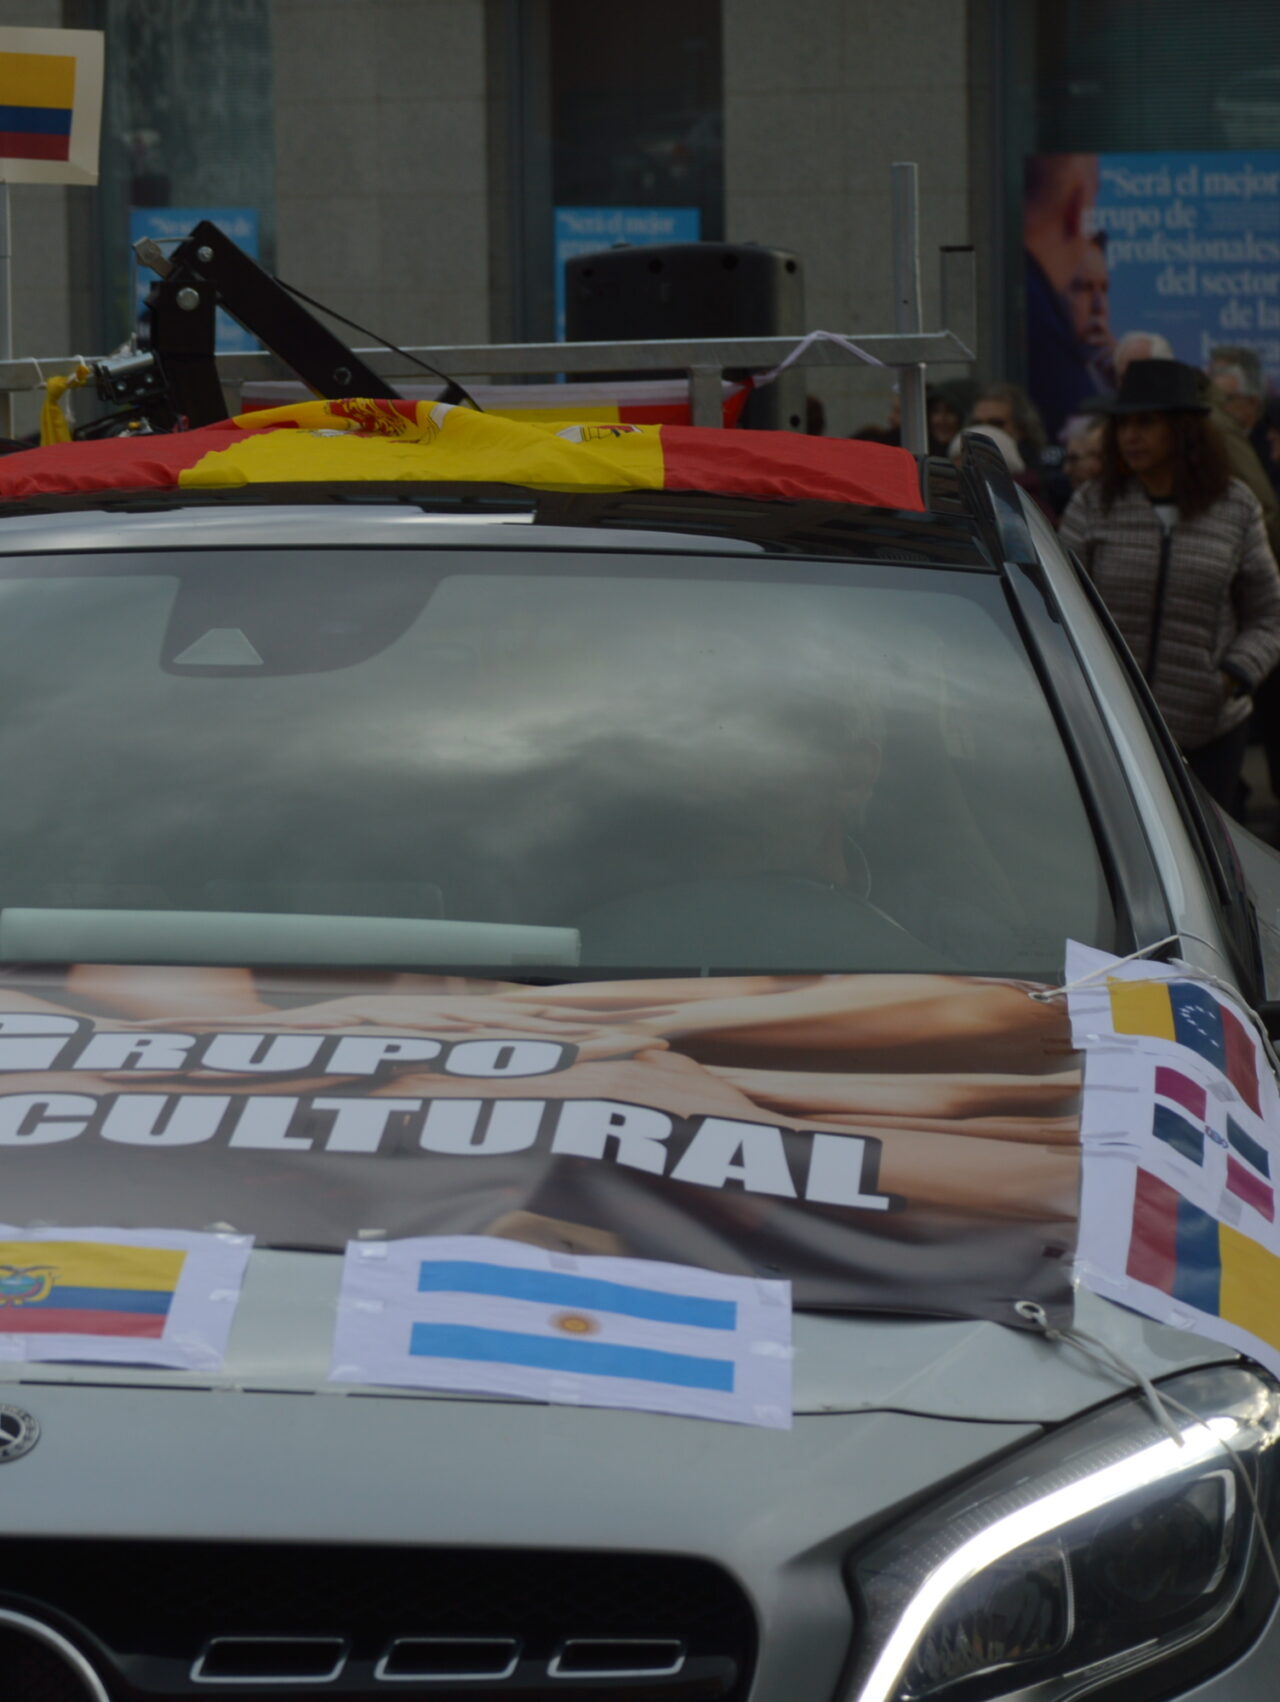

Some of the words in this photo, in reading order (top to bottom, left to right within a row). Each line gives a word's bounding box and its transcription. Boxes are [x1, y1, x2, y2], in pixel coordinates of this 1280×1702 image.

[1176, 164, 1198, 196] el
[1165, 199, 1197, 230] de
[1156, 264, 1196, 297] del
[1219, 298, 1253, 330] de
